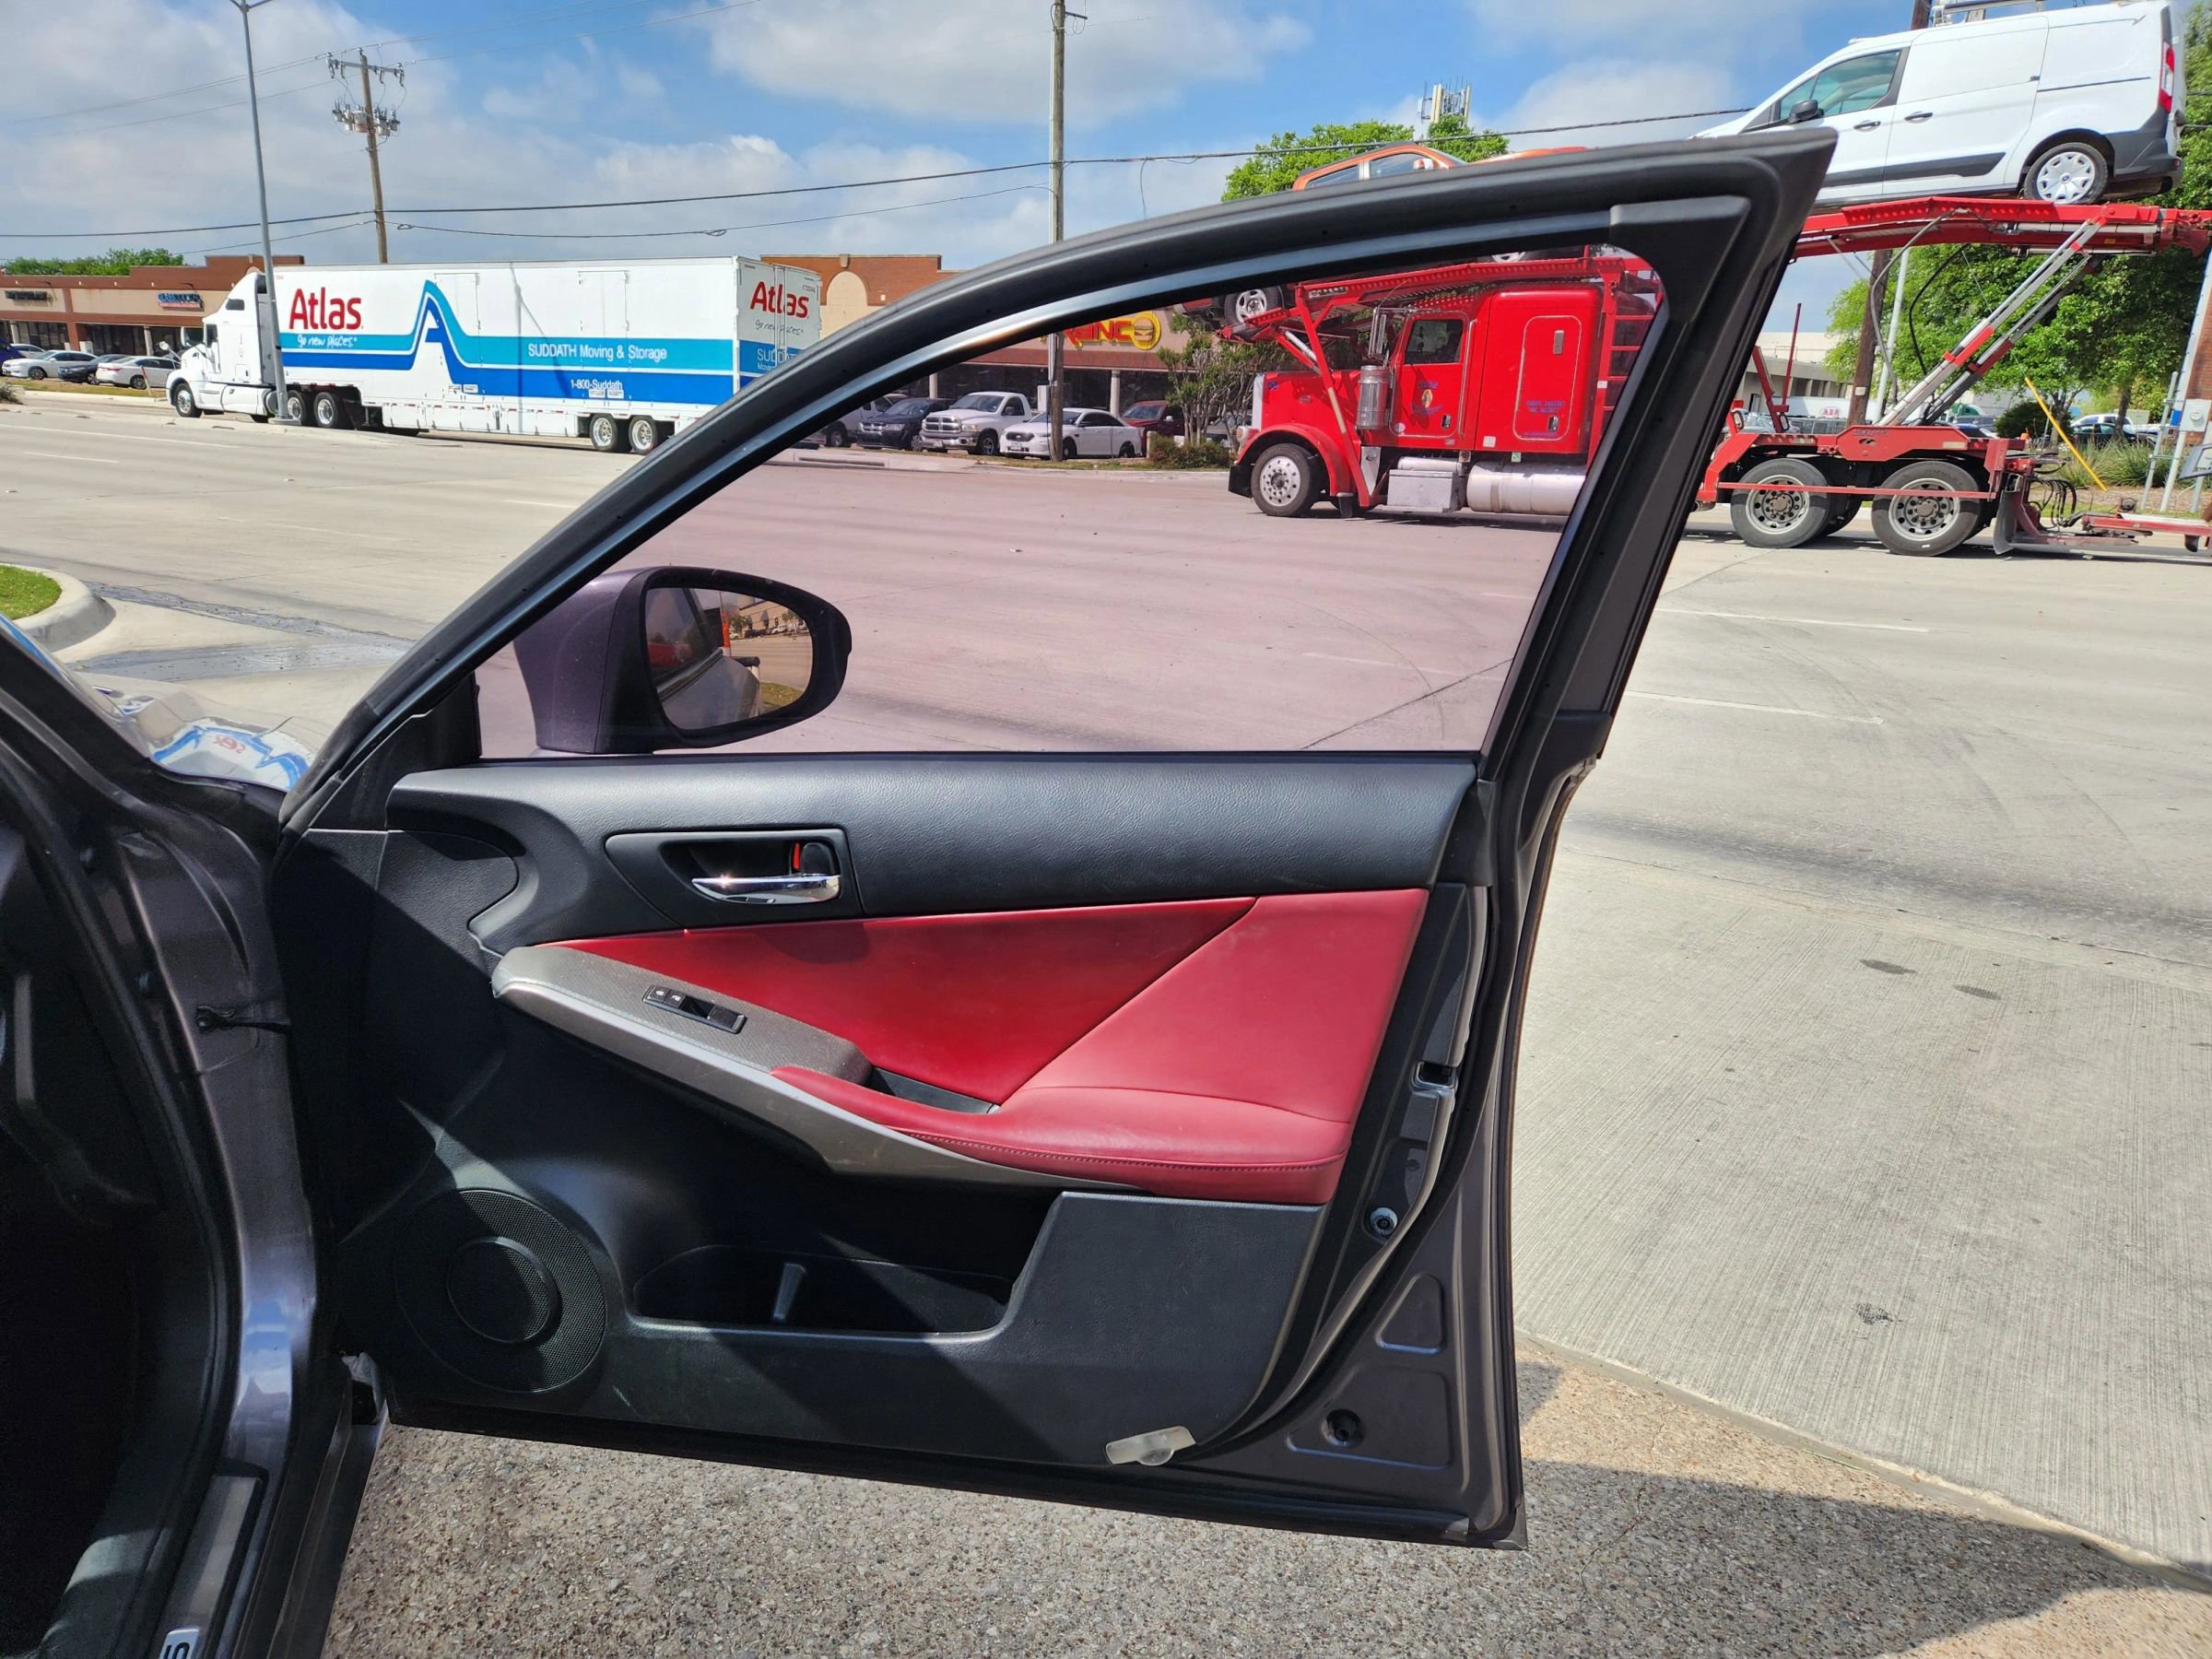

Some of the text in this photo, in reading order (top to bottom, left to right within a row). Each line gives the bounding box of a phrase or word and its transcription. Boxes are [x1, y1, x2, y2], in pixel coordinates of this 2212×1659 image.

[288, 287, 362, 330] Atlas
[750, 280, 810, 319] Atlas
[527, 343, 667, 363] SUDDATH Moving & Storage
[570, 378, 623, 391] 1-800-Suddath
